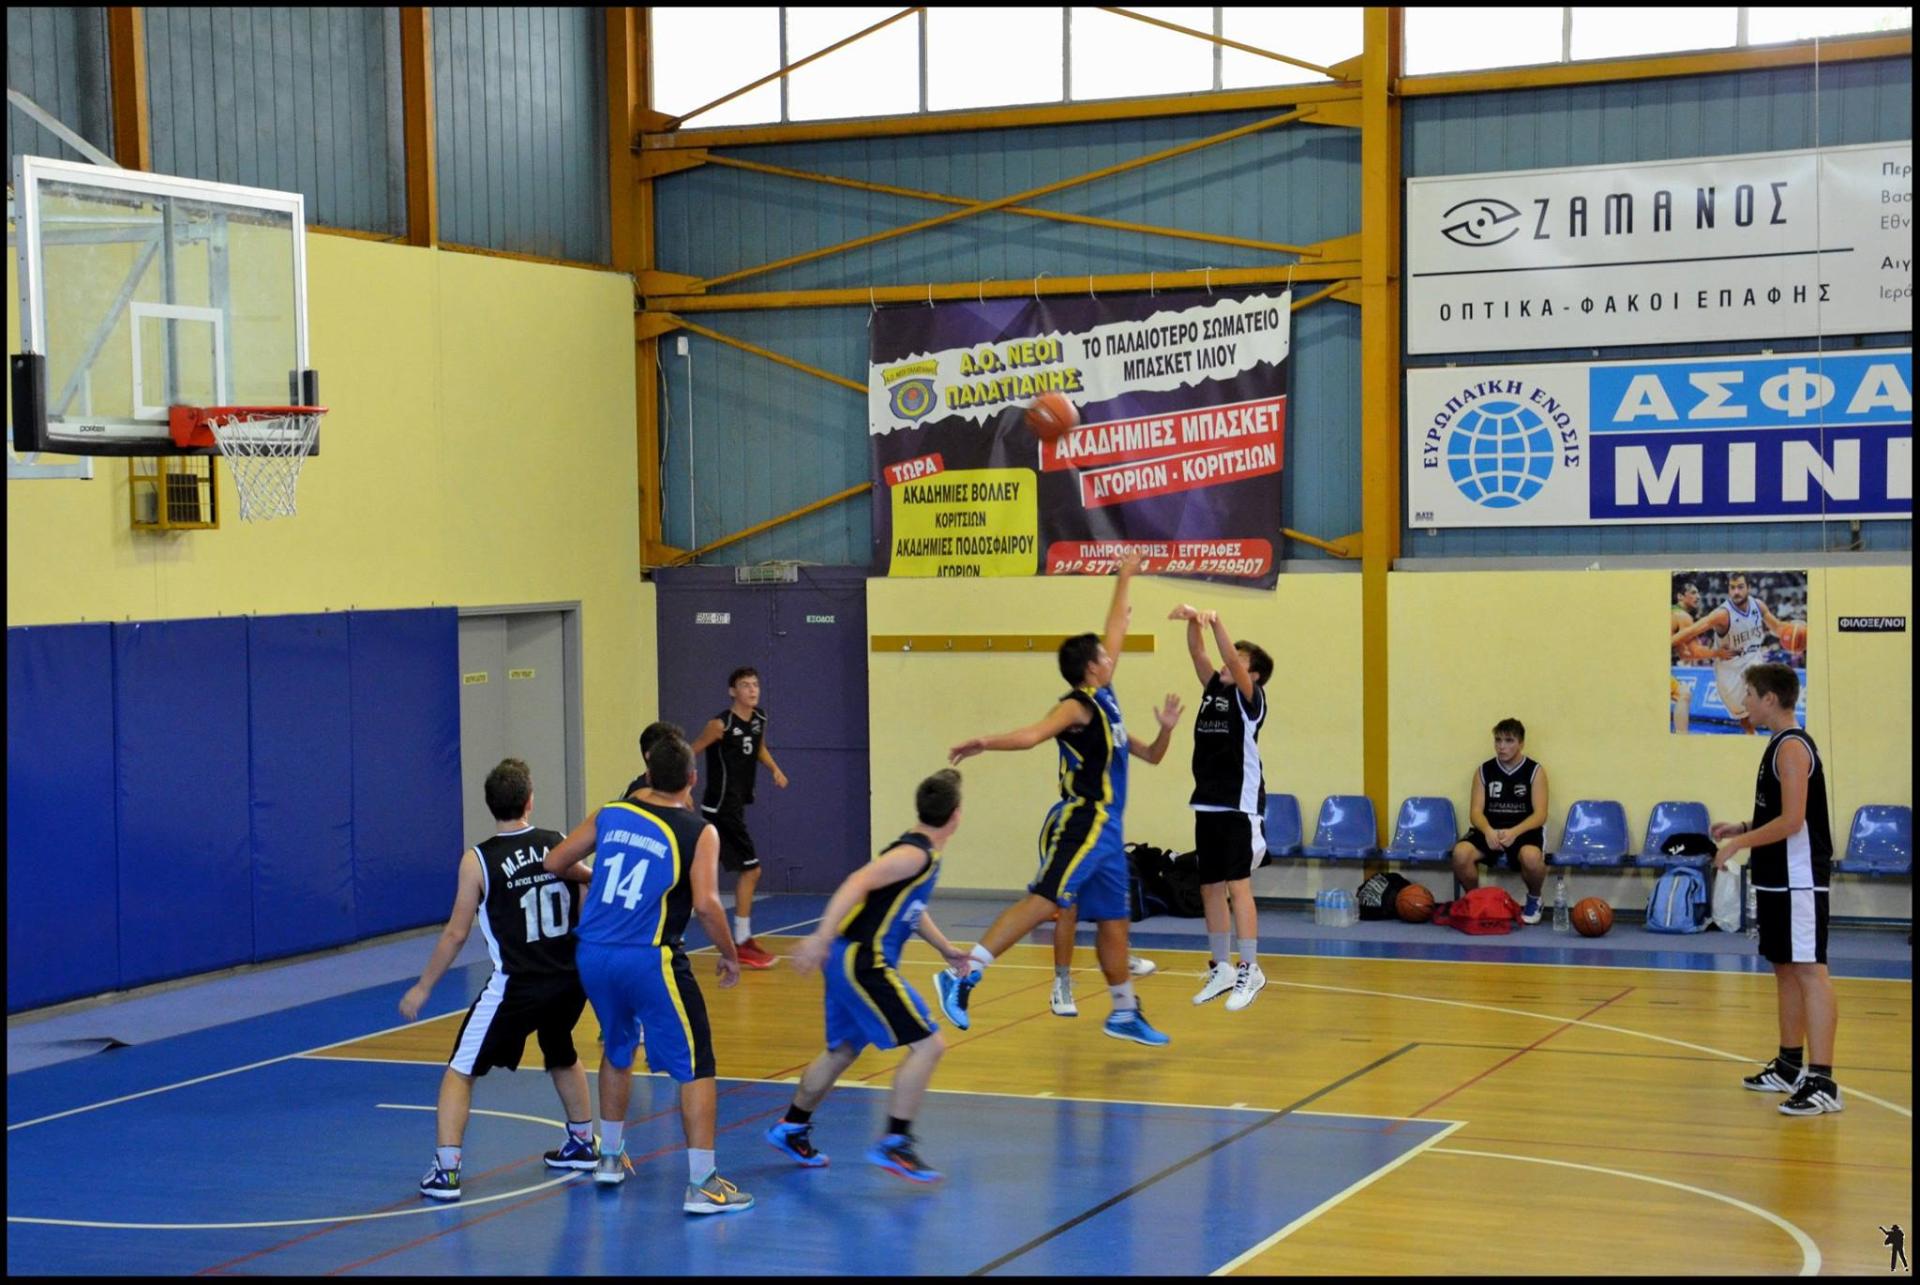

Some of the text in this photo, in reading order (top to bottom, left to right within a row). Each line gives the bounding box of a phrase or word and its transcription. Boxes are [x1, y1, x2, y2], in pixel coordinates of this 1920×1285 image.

[1533, 181, 1788, 240] ΖΑΜΑΝΟΣ
[1698, 283, 1831, 308] ΕΠΑΦΗΣ
[1082, 308, 1279, 359] ΤΟ ΠΑΛΑΙΟΤΕΡΟ ΣΩΜΑΤΕΙΟ
[960, 338, 1063, 377] Α.Ο. ΝΕΟΙ
[1124, 343, 1237, 382] ΜΠΑΣΚΕΤ ΙΛΙΟΥ
[945, 367, 1084, 410] ΠΑΛΑΤΙΑΝΗΣ
[1612, 363, 1912, 422] ΑΣΦΑ
[1055, 403, 1280, 459] ΑΚΑΔΗΜΙΕΣ ΜΠΑΣΚΕΤ
[1530, 387, 1580, 468] ΕΝΩΣΙΣ
[892, 456, 937, 483] ΤΩΡΑ
[1094, 464, 1167, 499] ΑΓΟΡΙΩΝ
[1182, 443, 1276, 483] ΚΟΡΙΤΣΙΩΝ
[903, 481, 1020, 505] ΑΚΑΔΗΜΙΕΣ ΒΟΛΛΕΥ
[935, 511, 986, 528] ΚΟΡΙΤΣΙΩΝ
[896, 534, 1034, 557] ΑΚΑΔΗΜΙΕΣ ΠΟΔΟΣΦΑΙΡΟΥ
[1179, 542, 1242, 558] ΕΓΓΡΑΦΕΣ
[743, 736, 753, 755] 5
[1488, 781, 1503, 798] 12
[602, 852, 650, 911] 14
[520, 881, 571, 943] 10
